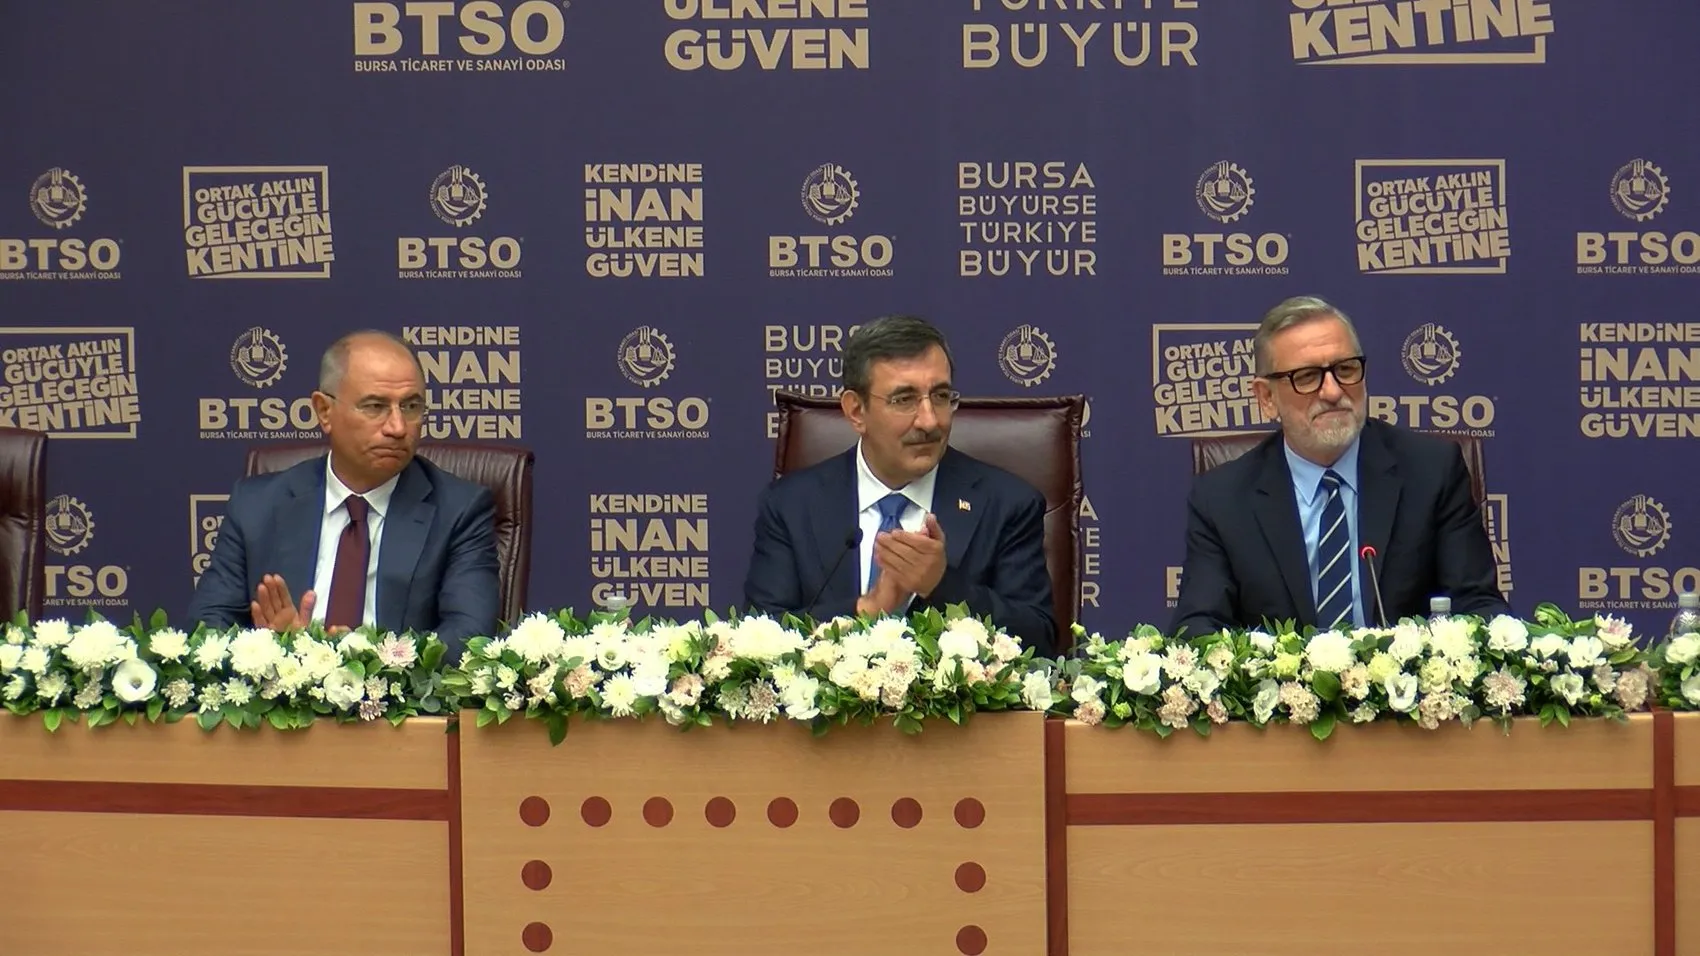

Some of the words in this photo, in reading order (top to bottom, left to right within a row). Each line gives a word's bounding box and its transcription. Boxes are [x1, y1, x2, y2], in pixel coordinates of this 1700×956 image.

[354, 0, 564, 55] BTSO
[664, 28, 869, 70] GÜVEN
[963, 22, 1198, 68] BÜYÜR
[355, 59, 397, 71] BURSA
[401, 58, 454, 71] TİCARET
[457, 59, 473, 71] VE
[476, 58, 523, 71] SANAYİ
[526, 59, 565, 71] ODASI
[585, 164, 702, 182] KENDİNE
[959, 162, 1095, 188] BURSA
[1367, 177, 1430, 197] ORTAK
[1435, 171, 1491, 191] AKLIN
[195, 184, 256, 203] ORTAK
[260, 177, 315, 196] AKLIN
[1369, 186, 1493, 218] GÜCÜYLE
[197, 193, 317, 223] GÜCÜYLE
[585, 188, 703, 221] İNAN
[959, 195, 1096, 215] BÜYÜRSE
[586, 227, 703, 248] ÜLKENE
[960, 221, 1096, 243] TÜRKİYE
[0, 239, 120, 270] BTSO
[186, 235, 335, 275] KENTİNE
[399, 237, 521, 269] BTSO
[769, 235, 893, 267] BTSO
[1163, 232, 1289, 265] BTSO
[1357, 229, 1511, 271] KENTİNE
[1577, 231, 1700, 264] BTSO
[426, 270, 456, 278] TİCARET
[469, 270, 497, 278] SANAYİ
[586, 253, 704, 277] GÜVEN
[797, 269, 827, 277] TİCARET
[841, 269, 868, 277] SANAYİ
[960, 250, 1096, 276] BÜYÜR
[1191, 267, 1222, 275] TİCARET
[1235, 267, 1263, 275] SANAYİ
[1577, 266, 1602, 274] BURSA
[1605, 265, 1636, 274] TİCARET
[1650, 265, 1679, 274] SANAYİ
[2, 344, 63, 364] ORTAK
[67, 338, 121, 358] AKLIN
[765, 325, 861, 352] BUR
[1164, 340, 1228, 361] ORTAK
[4, 353, 123, 385] GÜCÜYLE
[418, 351, 520, 383] NAN
[766, 358, 844, 378] BÜYÜ
[1167, 354, 1256, 381] GÜCÜY
[1581, 347, 1700, 381] İNAN
[425, 389, 521, 410] LKENE
[1154, 375, 1255, 405] GELECE
[1581, 386, 1700, 408] ÜLKENE
[0, 395, 141, 431] KENTİNE
[200, 397, 320, 430] BTSO
[586, 397, 709, 430] BTSO
[1155, 398, 1276, 434] KENTİ
[1369, 395, 1495, 428] BTSO
[227, 431, 257, 439] TİCARET
[270, 431, 297, 439] SANAYİ
[586, 431, 611, 439] BURSA
[613, 430, 644, 439] TİCARET
[646, 431, 655, 439] VE
[657, 430, 685, 439] SANAYİ
[686, 431, 709, 439] ODASI
[1581, 413, 1700, 438] GÜVEN
[590, 494, 708, 513] KENDİNE
[591, 518, 708, 551] İNAN
[591, 557, 709, 578] ÜLKENE
[44, 565, 128, 597] TSO
[1579, 567, 1700, 599] BTSO
[78, 598, 104, 606] SANAYİ
[592, 582, 709, 607] GÜVEN
[1580, 601, 1605, 609] BURSA
[1607, 600, 1638, 609] TİCARET
